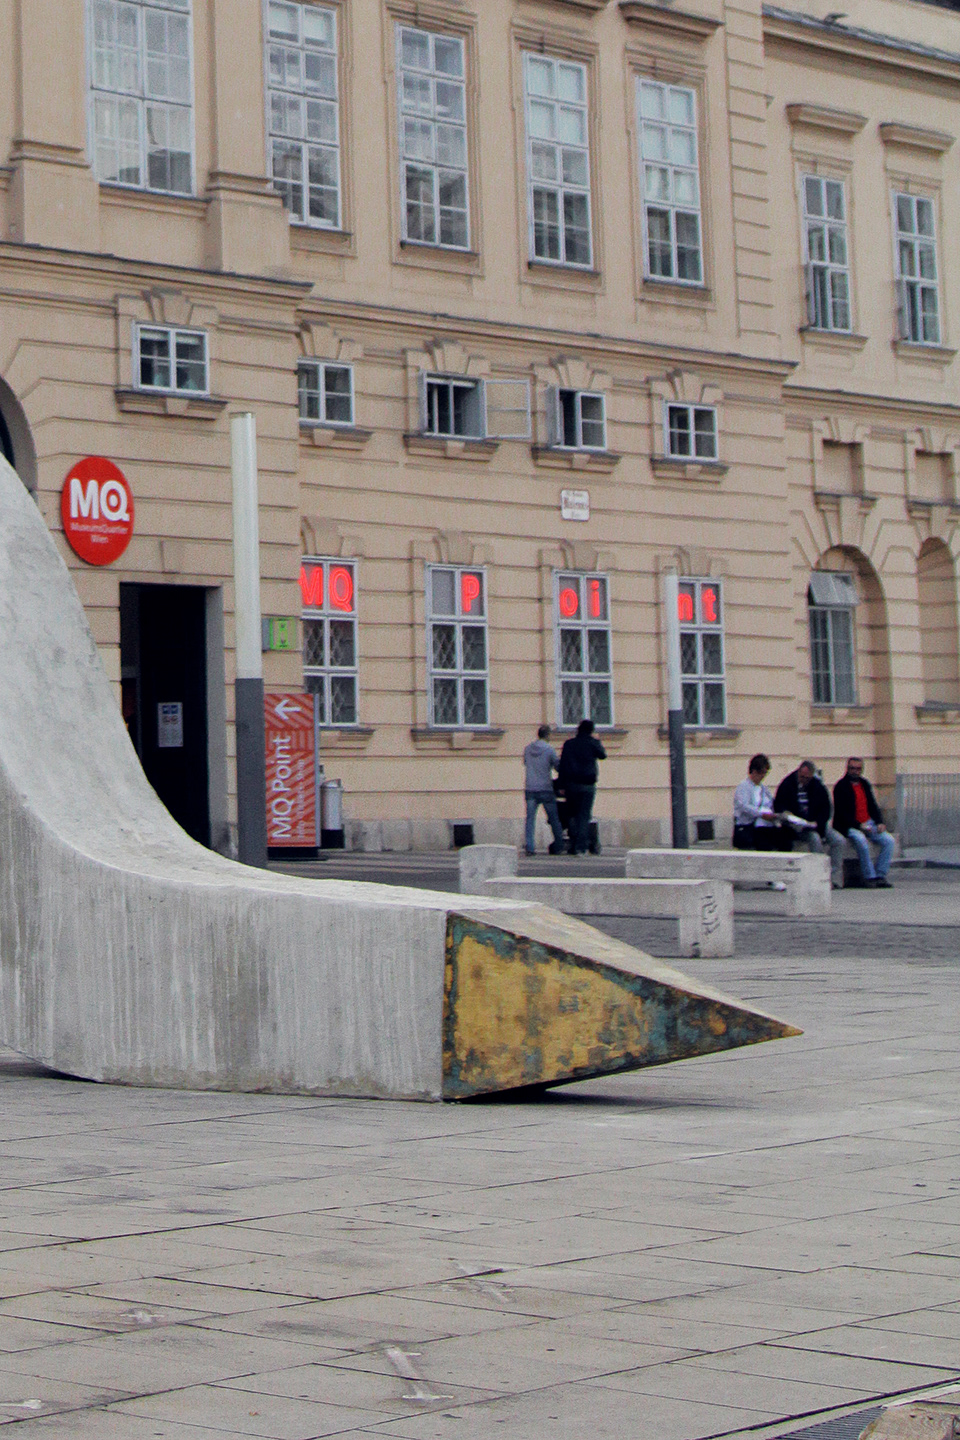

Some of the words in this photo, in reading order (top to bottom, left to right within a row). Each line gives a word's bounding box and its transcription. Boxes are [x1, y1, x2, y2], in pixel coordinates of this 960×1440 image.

[70, 478, 130, 522] MQ
[298, 565, 354, 613] MQ
[270, 735, 293, 793] Point
[271, 797, 294, 839] MQ
